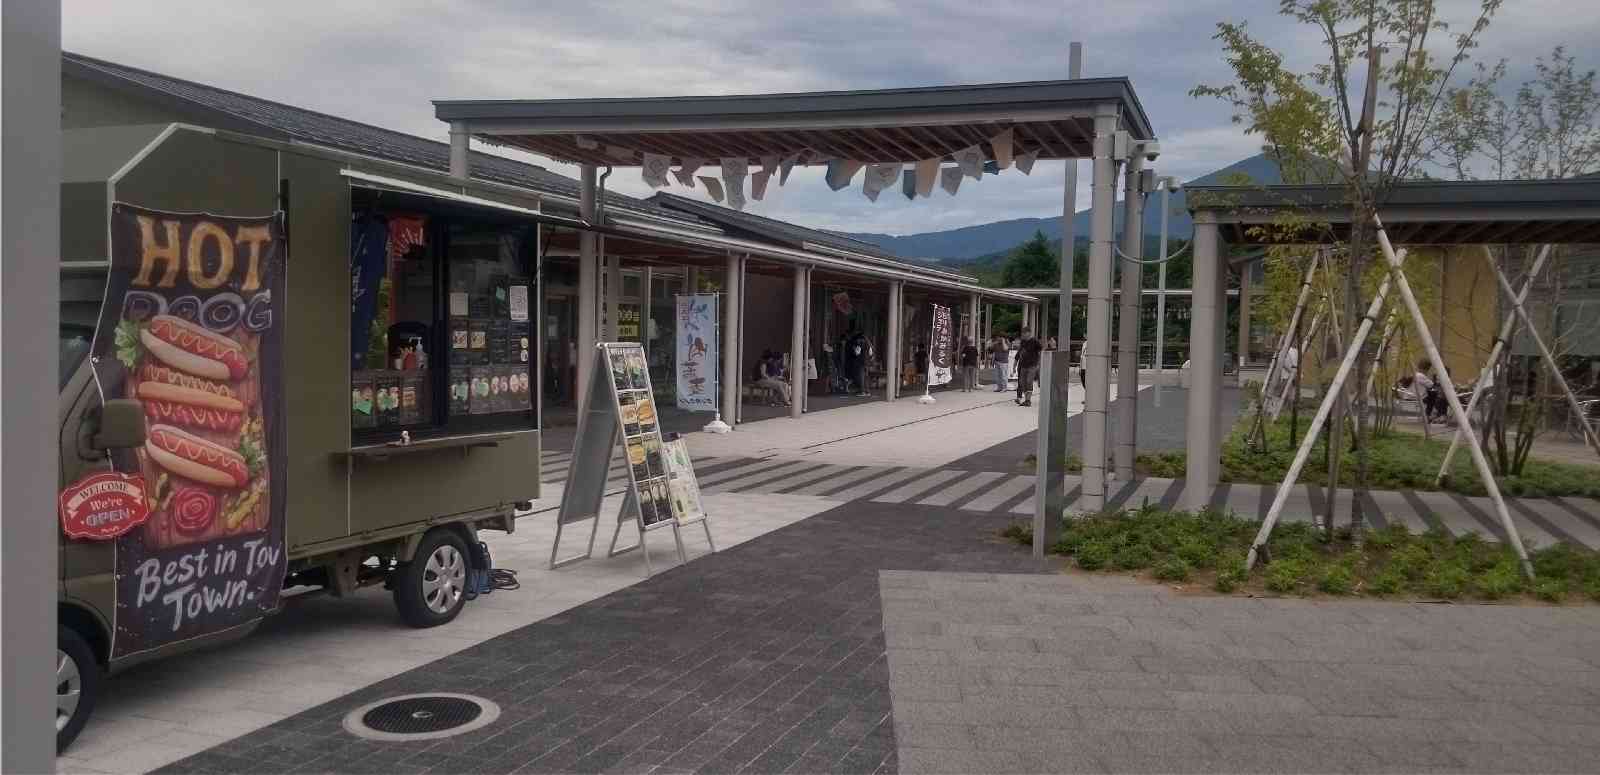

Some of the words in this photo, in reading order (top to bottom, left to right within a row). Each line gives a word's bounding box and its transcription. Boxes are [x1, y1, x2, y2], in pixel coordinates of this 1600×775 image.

[131, 216, 272, 291] HOT
[80, 481, 128, 499] WELCOME
[90, 498, 123, 511] We're
[86, 508, 129, 526] OPEN
[134, 548, 208, 608] Best
[214, 544, 237, 574] in
[163, 582, 255, 632] Town.
